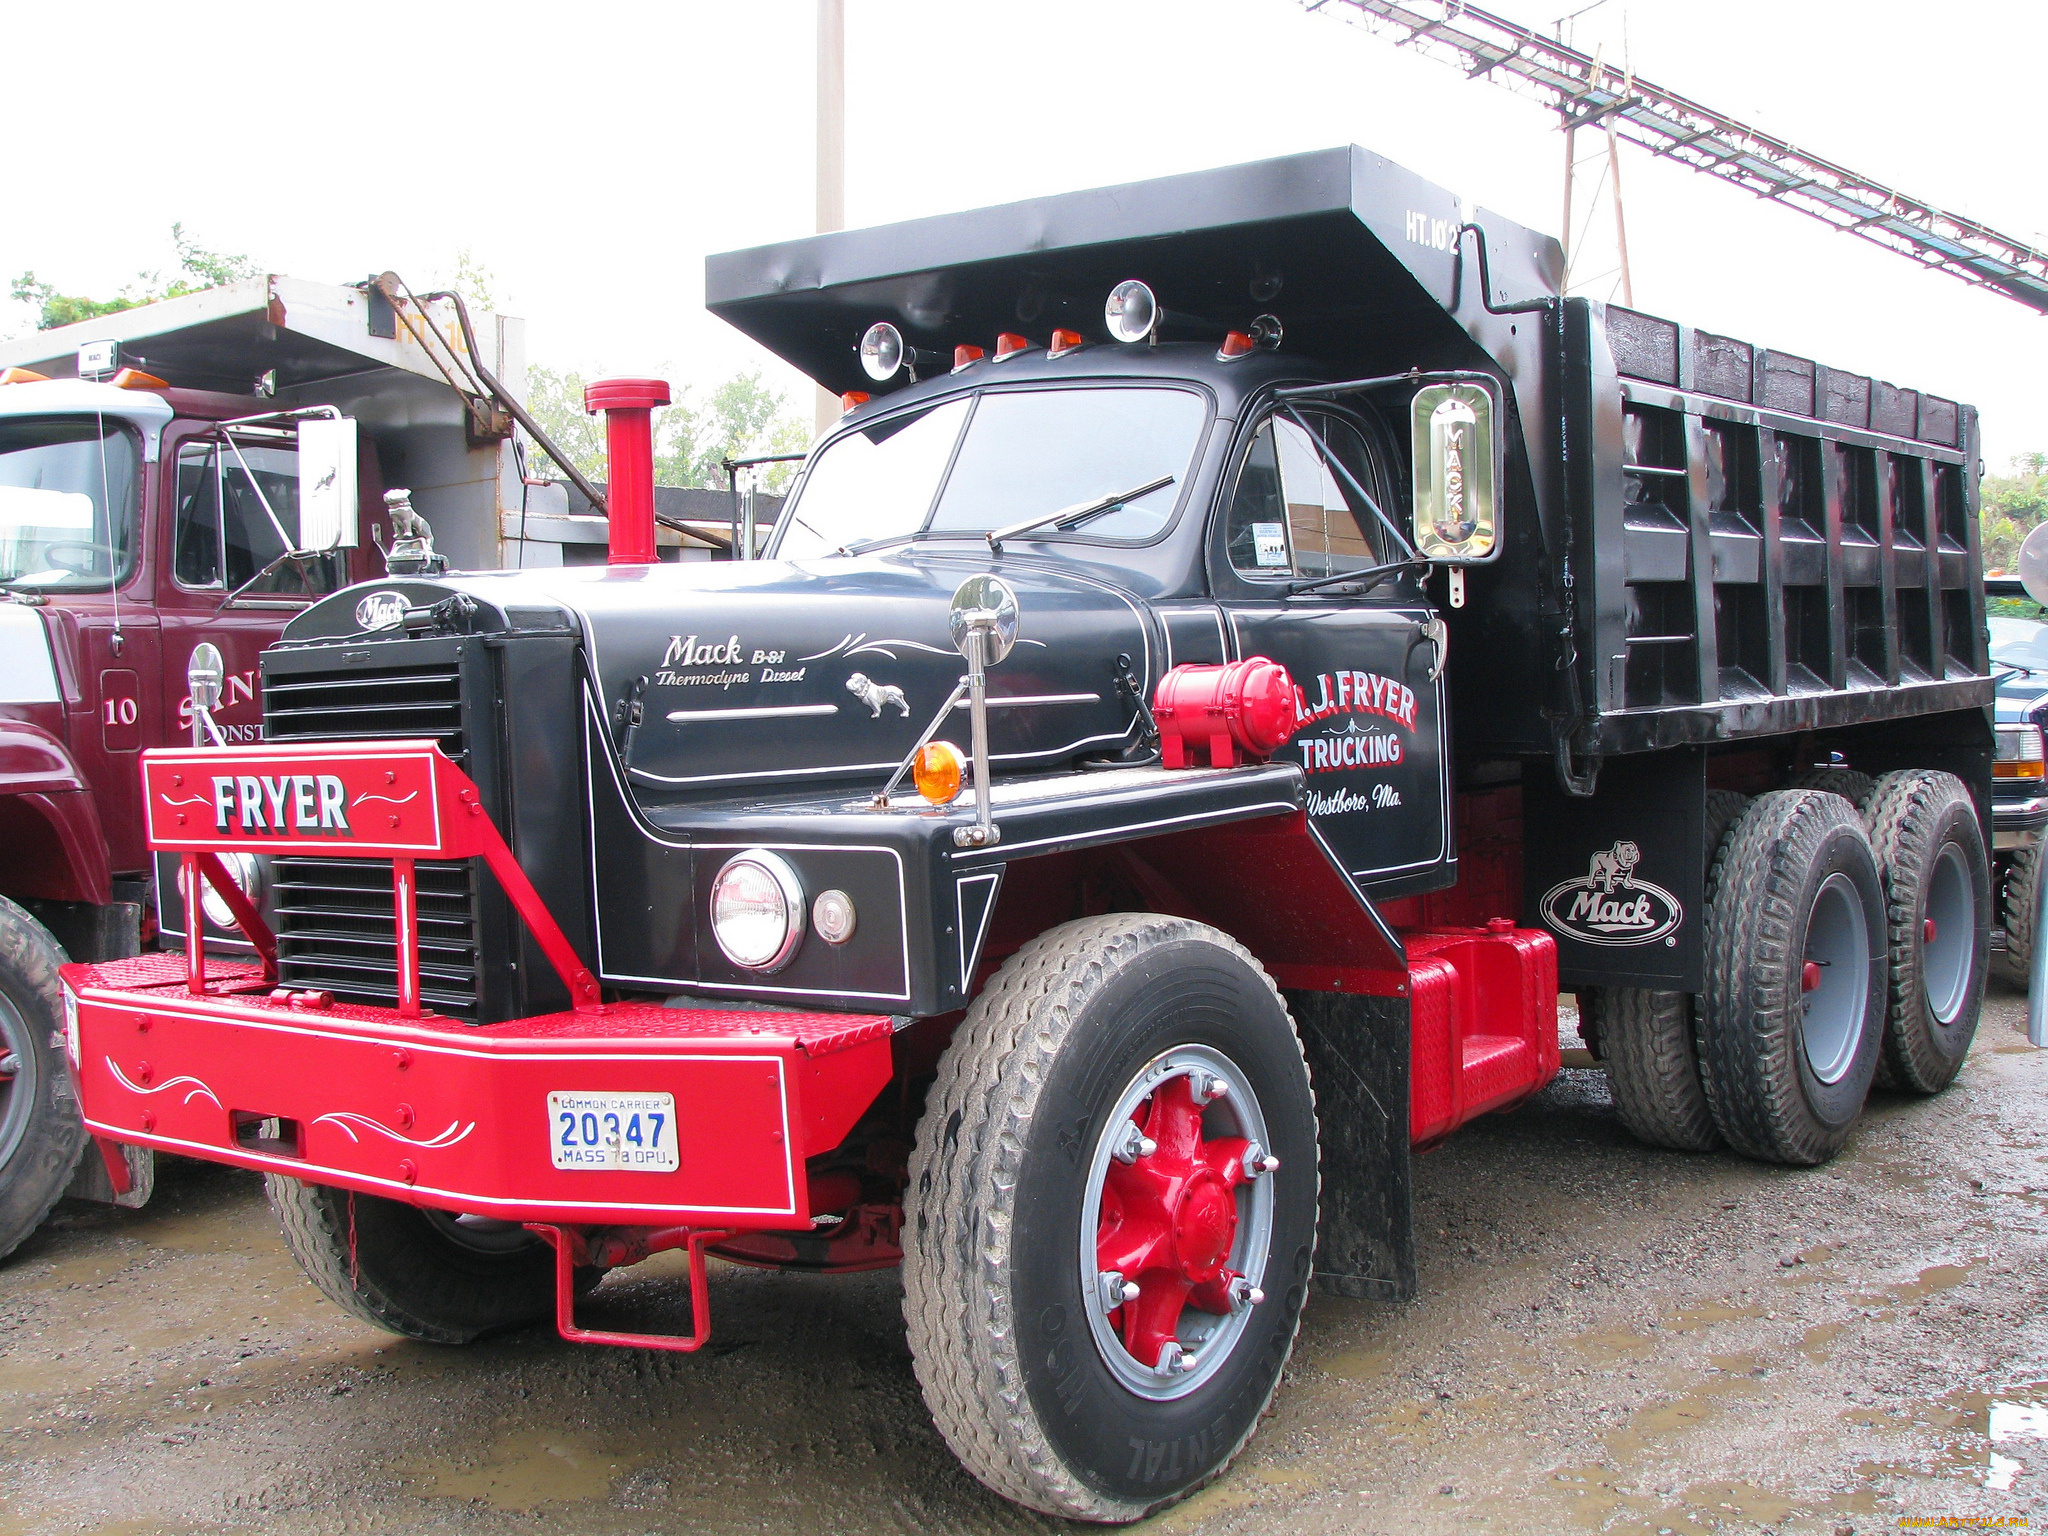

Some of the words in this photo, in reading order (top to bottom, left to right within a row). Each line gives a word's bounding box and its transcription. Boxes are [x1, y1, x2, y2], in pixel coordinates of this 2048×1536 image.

[362, 596, 404, 624] Mack
[661, 634, 743, 668] Mack
[655, 669, 750, 691] Thermodyne
[760, 667, 807, 683] Diesel
[104, 697, 138, 725] 10
[1298, 734, 1402, 771] TRUCKING
[211, 775, 353, 834] FRYER
[1306, 787, 1369, 816] Westboro,
[1372, 784, 1402, 809] Ma.
[1566, 891, 1655, 929] Mack
[561, 1099, 607, 1109] COMMON
[611, 1099, 660, 1110] CARRIER
[560, 1112, 665, 1147] 20347
[564, 1150, 605, 1162] MASS
